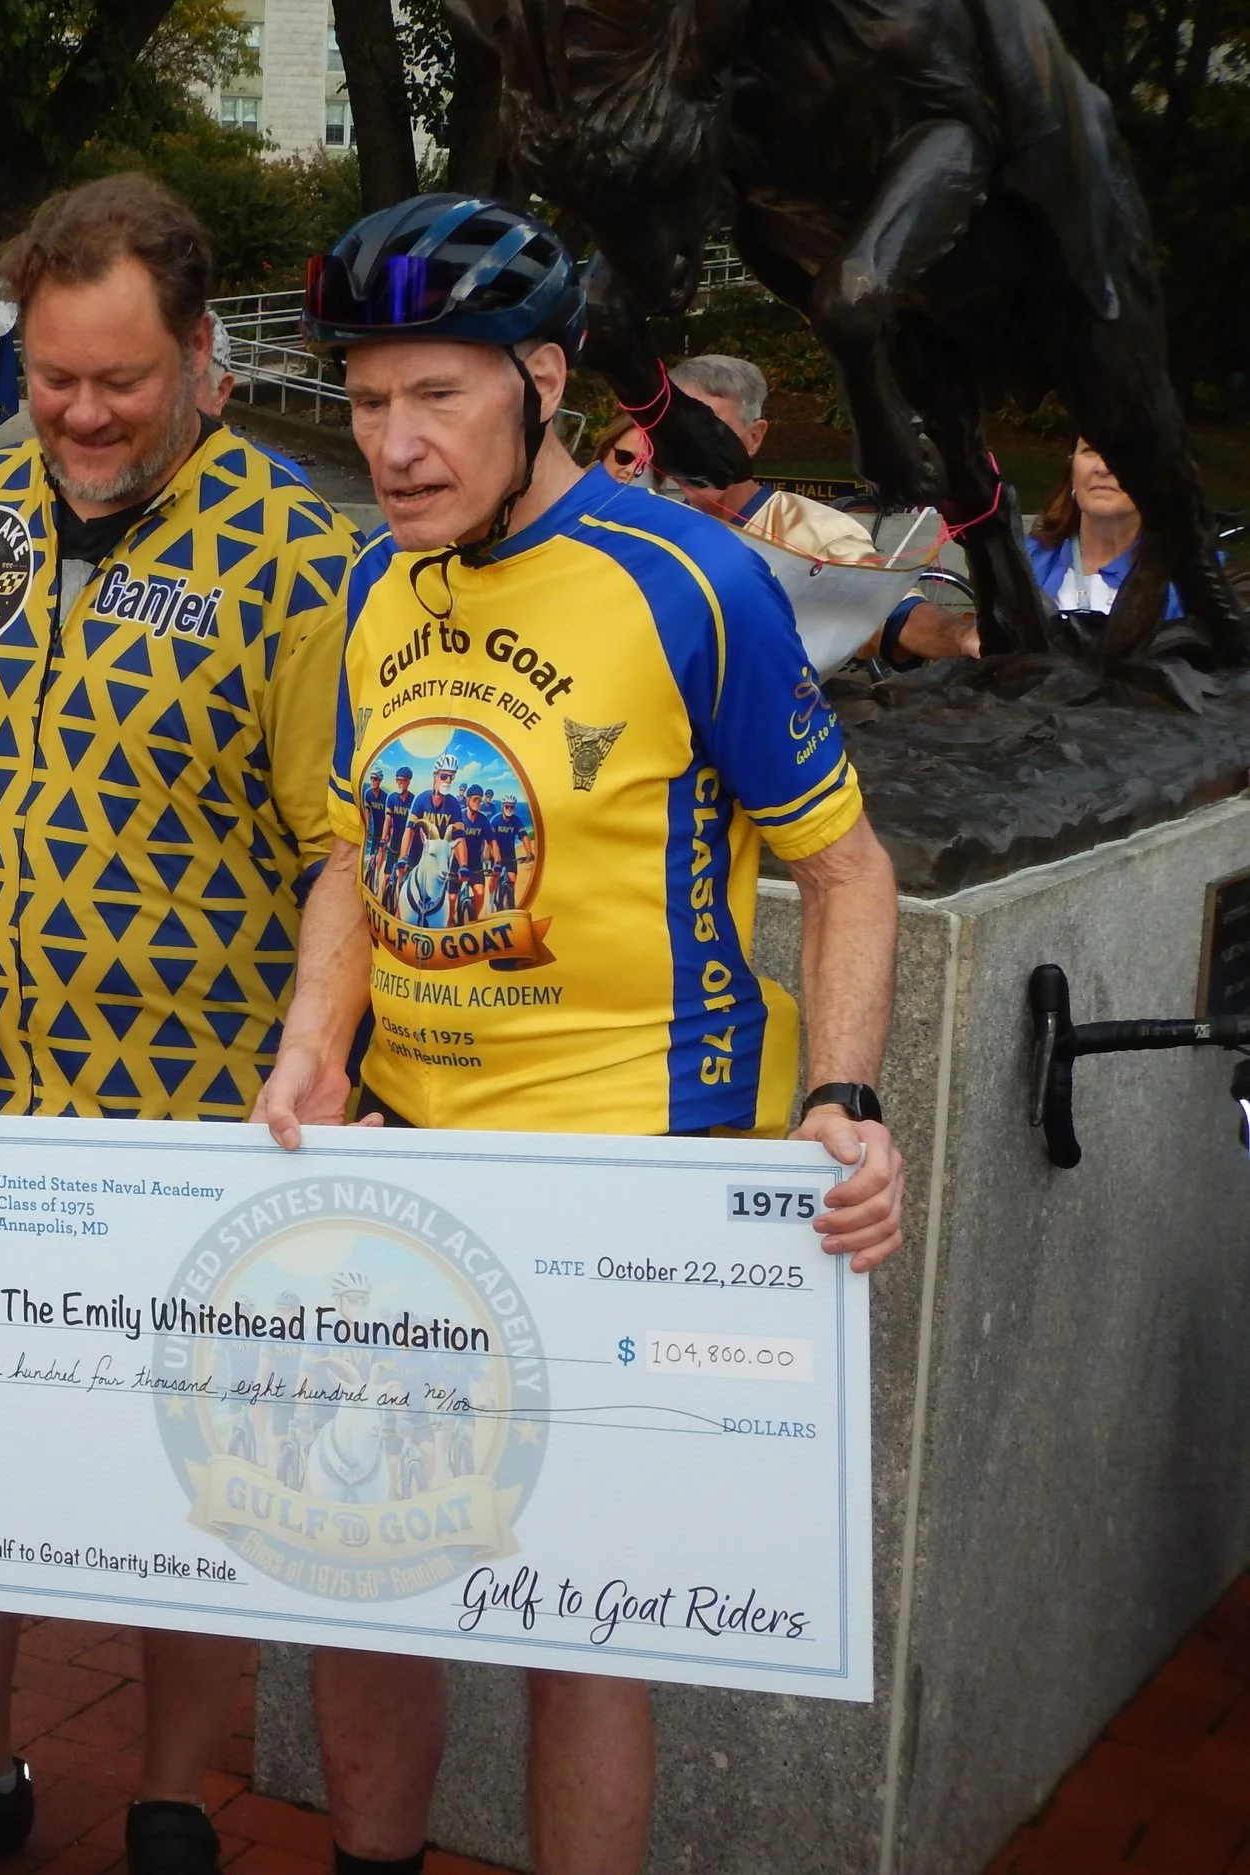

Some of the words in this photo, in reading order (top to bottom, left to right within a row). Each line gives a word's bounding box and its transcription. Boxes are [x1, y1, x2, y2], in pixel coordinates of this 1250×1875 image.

[795, 483, 838, 498] HALL
[96, 563, 223, 639] Ganjei
[378, 621, 432, 689] Gulf
[438, 619, 471, 655] to
[484, 628, 575, 707] Goat
[382, 679, 449, 719] CHARITY
[449, 679, 498, 704] BIKE
[496, 691, 542, 731] RIDE
[796, 735, 818, 766] Gulf
[817, 726, 829, 742] to
[422, 811, 453, 827] NAVY
[690, 767, 721, 943] CLASS
[364, 899, 410, 953] GULF
[440, 922, 515, 960] GOAT
[373, 966, 411, 1000] STATES
[467, 985, 564, 1008] ACADEMY
[381, 1015, 411, 1039] Class
[413, 1027, 427, 1044] of
[430, 1029, 476, 1047] 1975
[386, 1038, 413, 1059] 50th
[414, 1043, 483, 1069] Reunion
[700, 1025, 736, 1085] 75
[40, 1197, 58, 1213] of
[60, 1200, 95, 1216] 1975
[50, 1177, 98, 1194] States
[102, 1179, 147, 1196] Naval
[150, 1181, 225, 1202] Academy
[731, 1190, 816, 1218] 1975
[81, 1220, 109, 1236] MD
[218, 1182, 325, 1255] STATES
[333, 1182, 439, 1240] NAVAL
[441, 1229, 545, 1394] ACADEMY
[534, 1259, 585, 1277] DATE
[597, 1256, 678, 1281] October
[0, 1288, 54, 1325] The
[63, 1291, 142, 1341] Emily
[151, 1296, 305, 1341] Whitehead
[315, 1306, 490, 1352] Foundation
[617, 1336, 636, 1366] $
[7, 1352, 82, 1386] hundred
[87, 1354, 126, 1394] four
[230, 1366, 286, 1408] eight
[290, 1371, 370, 1406] hundred
[376, 1386, 412, 1408] and
[722, 1416, 817, 1439] DOLLARS
[226, 1472, 329, 1541] GULF
[377, 1497, 474, 1546] GOAT
[19, 1545, 35, 1562] to
[40, 1543, 80, 1566] Goat
[85, 1547, 148, 1578] Charity
[153, 1553, 191, 1578] Bike
[196, 1557, 237, 1581] Ride
[458, 1565, 543, 1632] Gulf
[557, 1578, 583, 1618] to
[589, 1579, 676, 1645] Goat
[685, 1586, 811, 1638] Riders
